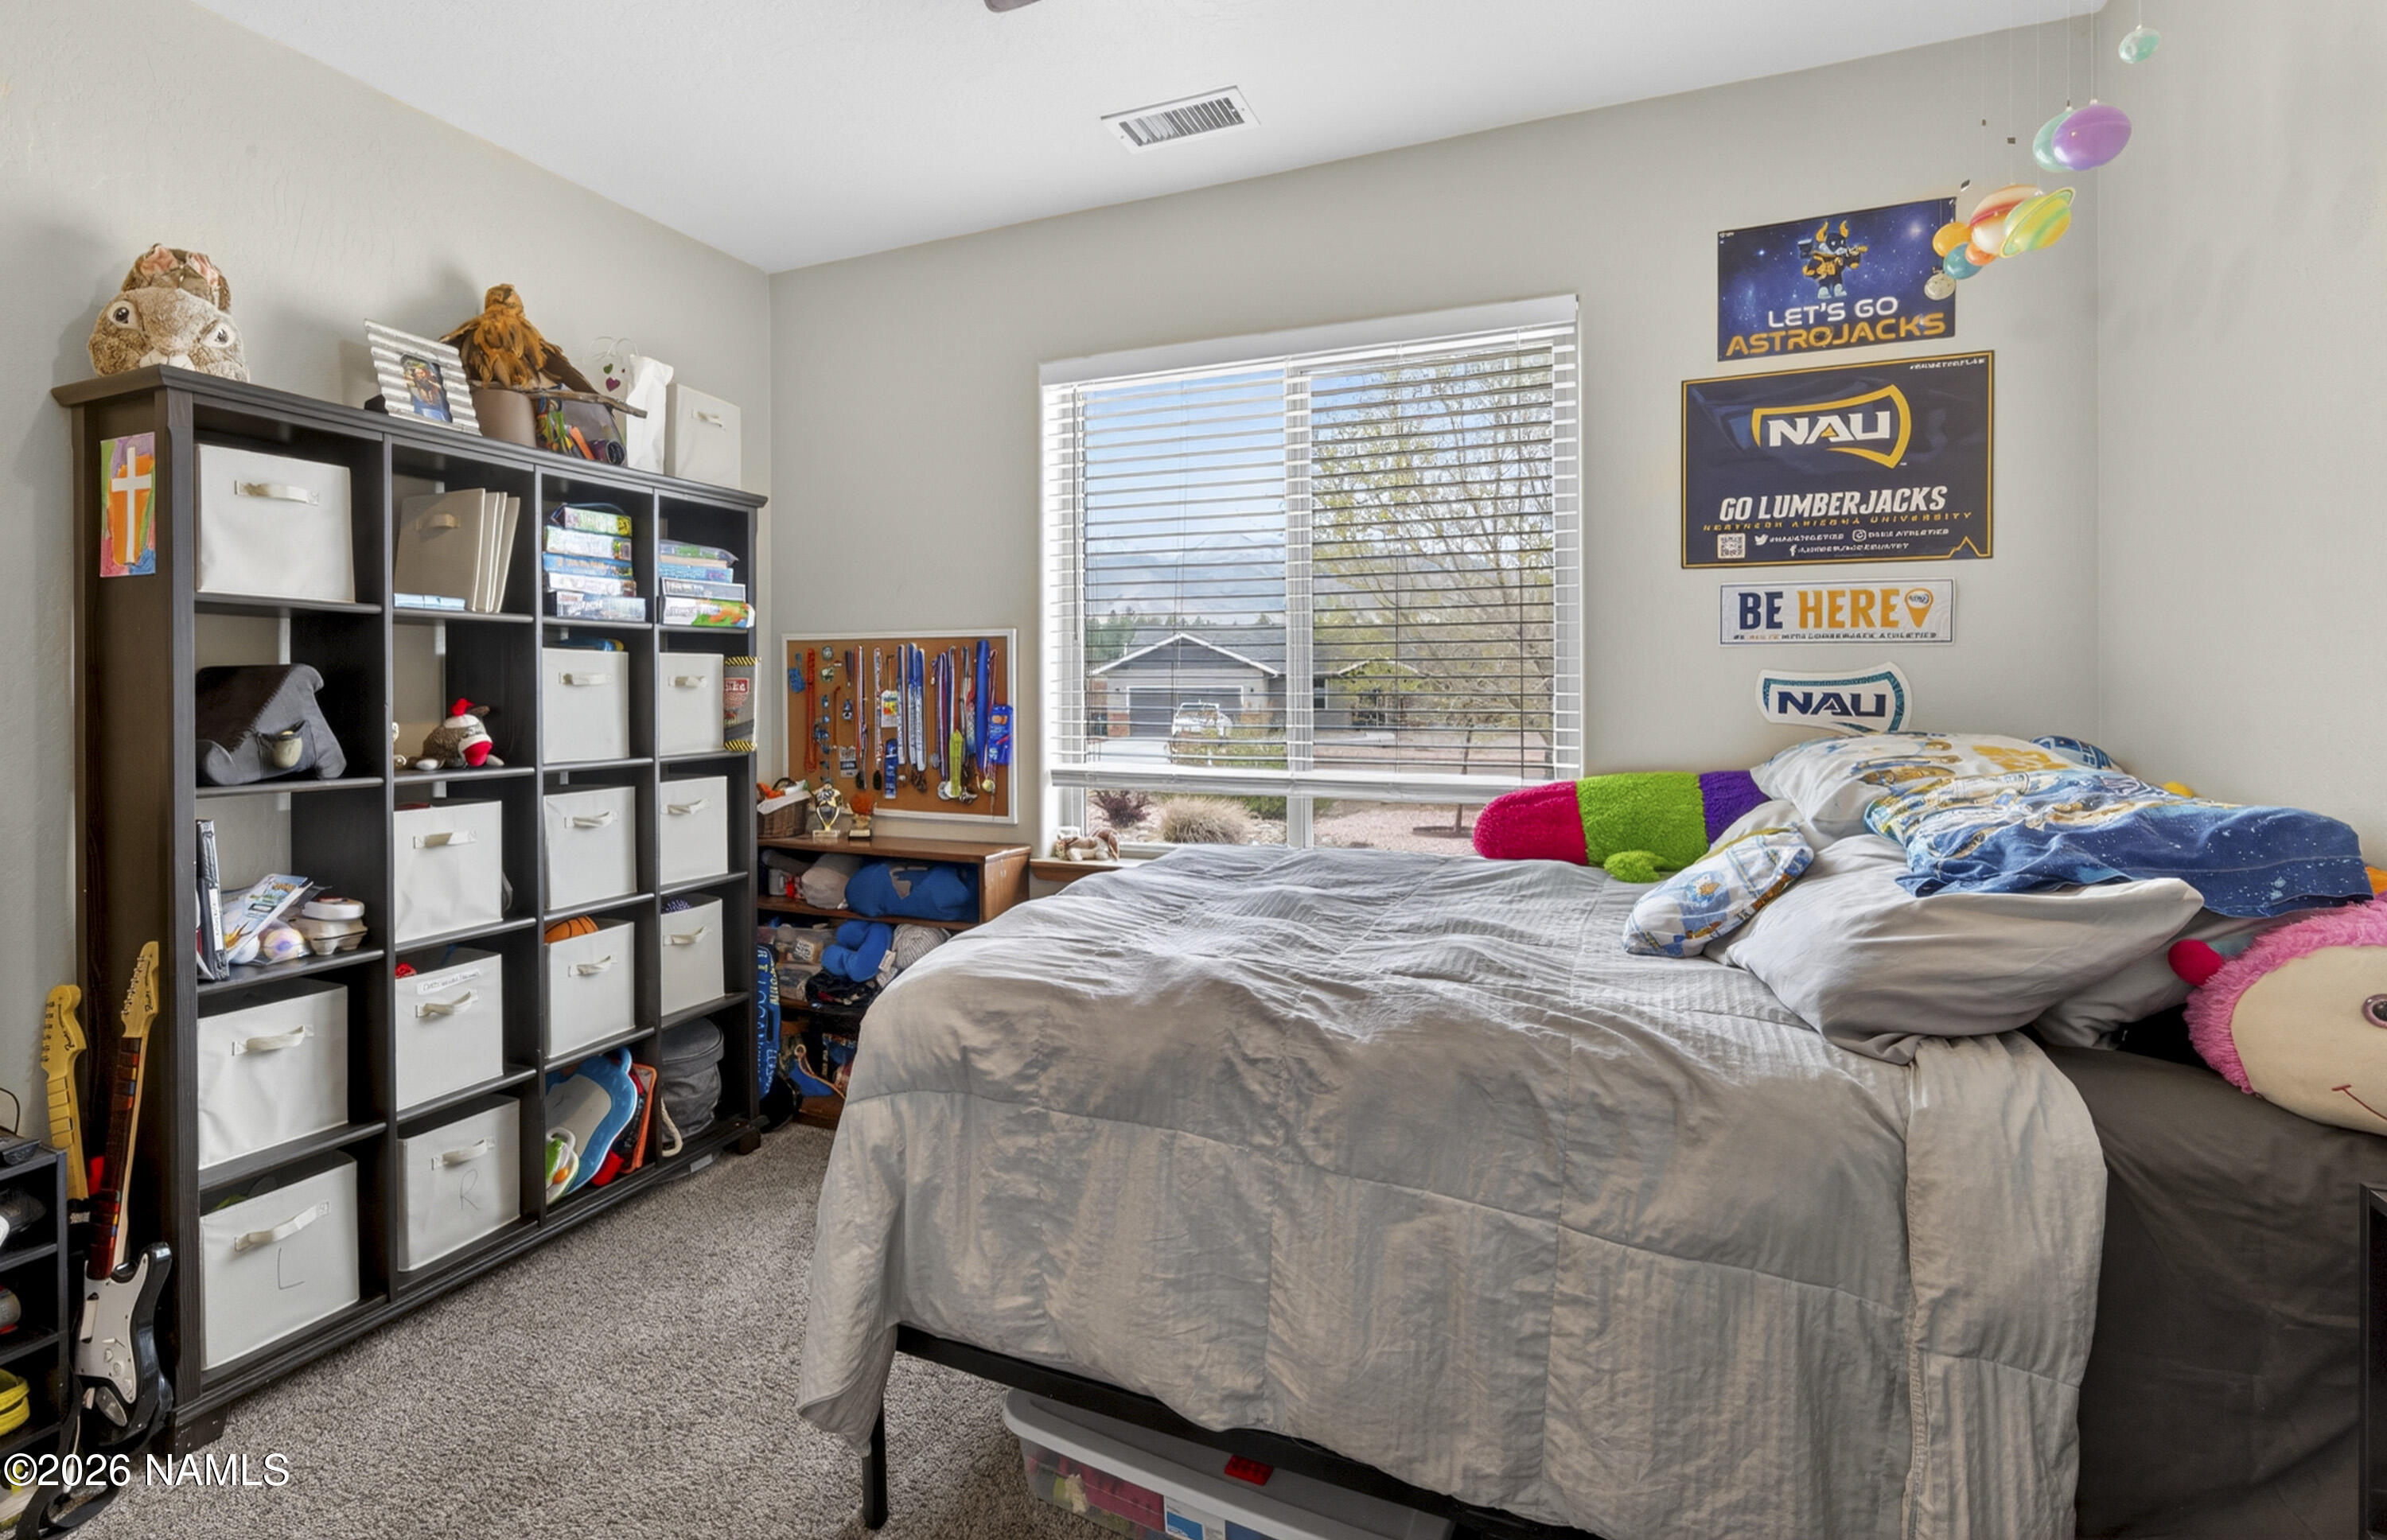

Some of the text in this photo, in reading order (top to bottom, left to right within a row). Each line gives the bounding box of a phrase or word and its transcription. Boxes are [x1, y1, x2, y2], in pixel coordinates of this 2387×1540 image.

[1767, 296, 1898, 329] LET'S GO
[1725, 313, 1946, 356] ASTROJACKS
[1768, 410, 1891, 447] NAU
[1719, 485, 1949, 522] GO LUMBERJACKS
[1738, 589, 1901, 630] BE HERE
[1777, 691, 1887, 718] NAU
[459, 1167, 480, 1211] R
[277, 1246, 306, 1290] L
